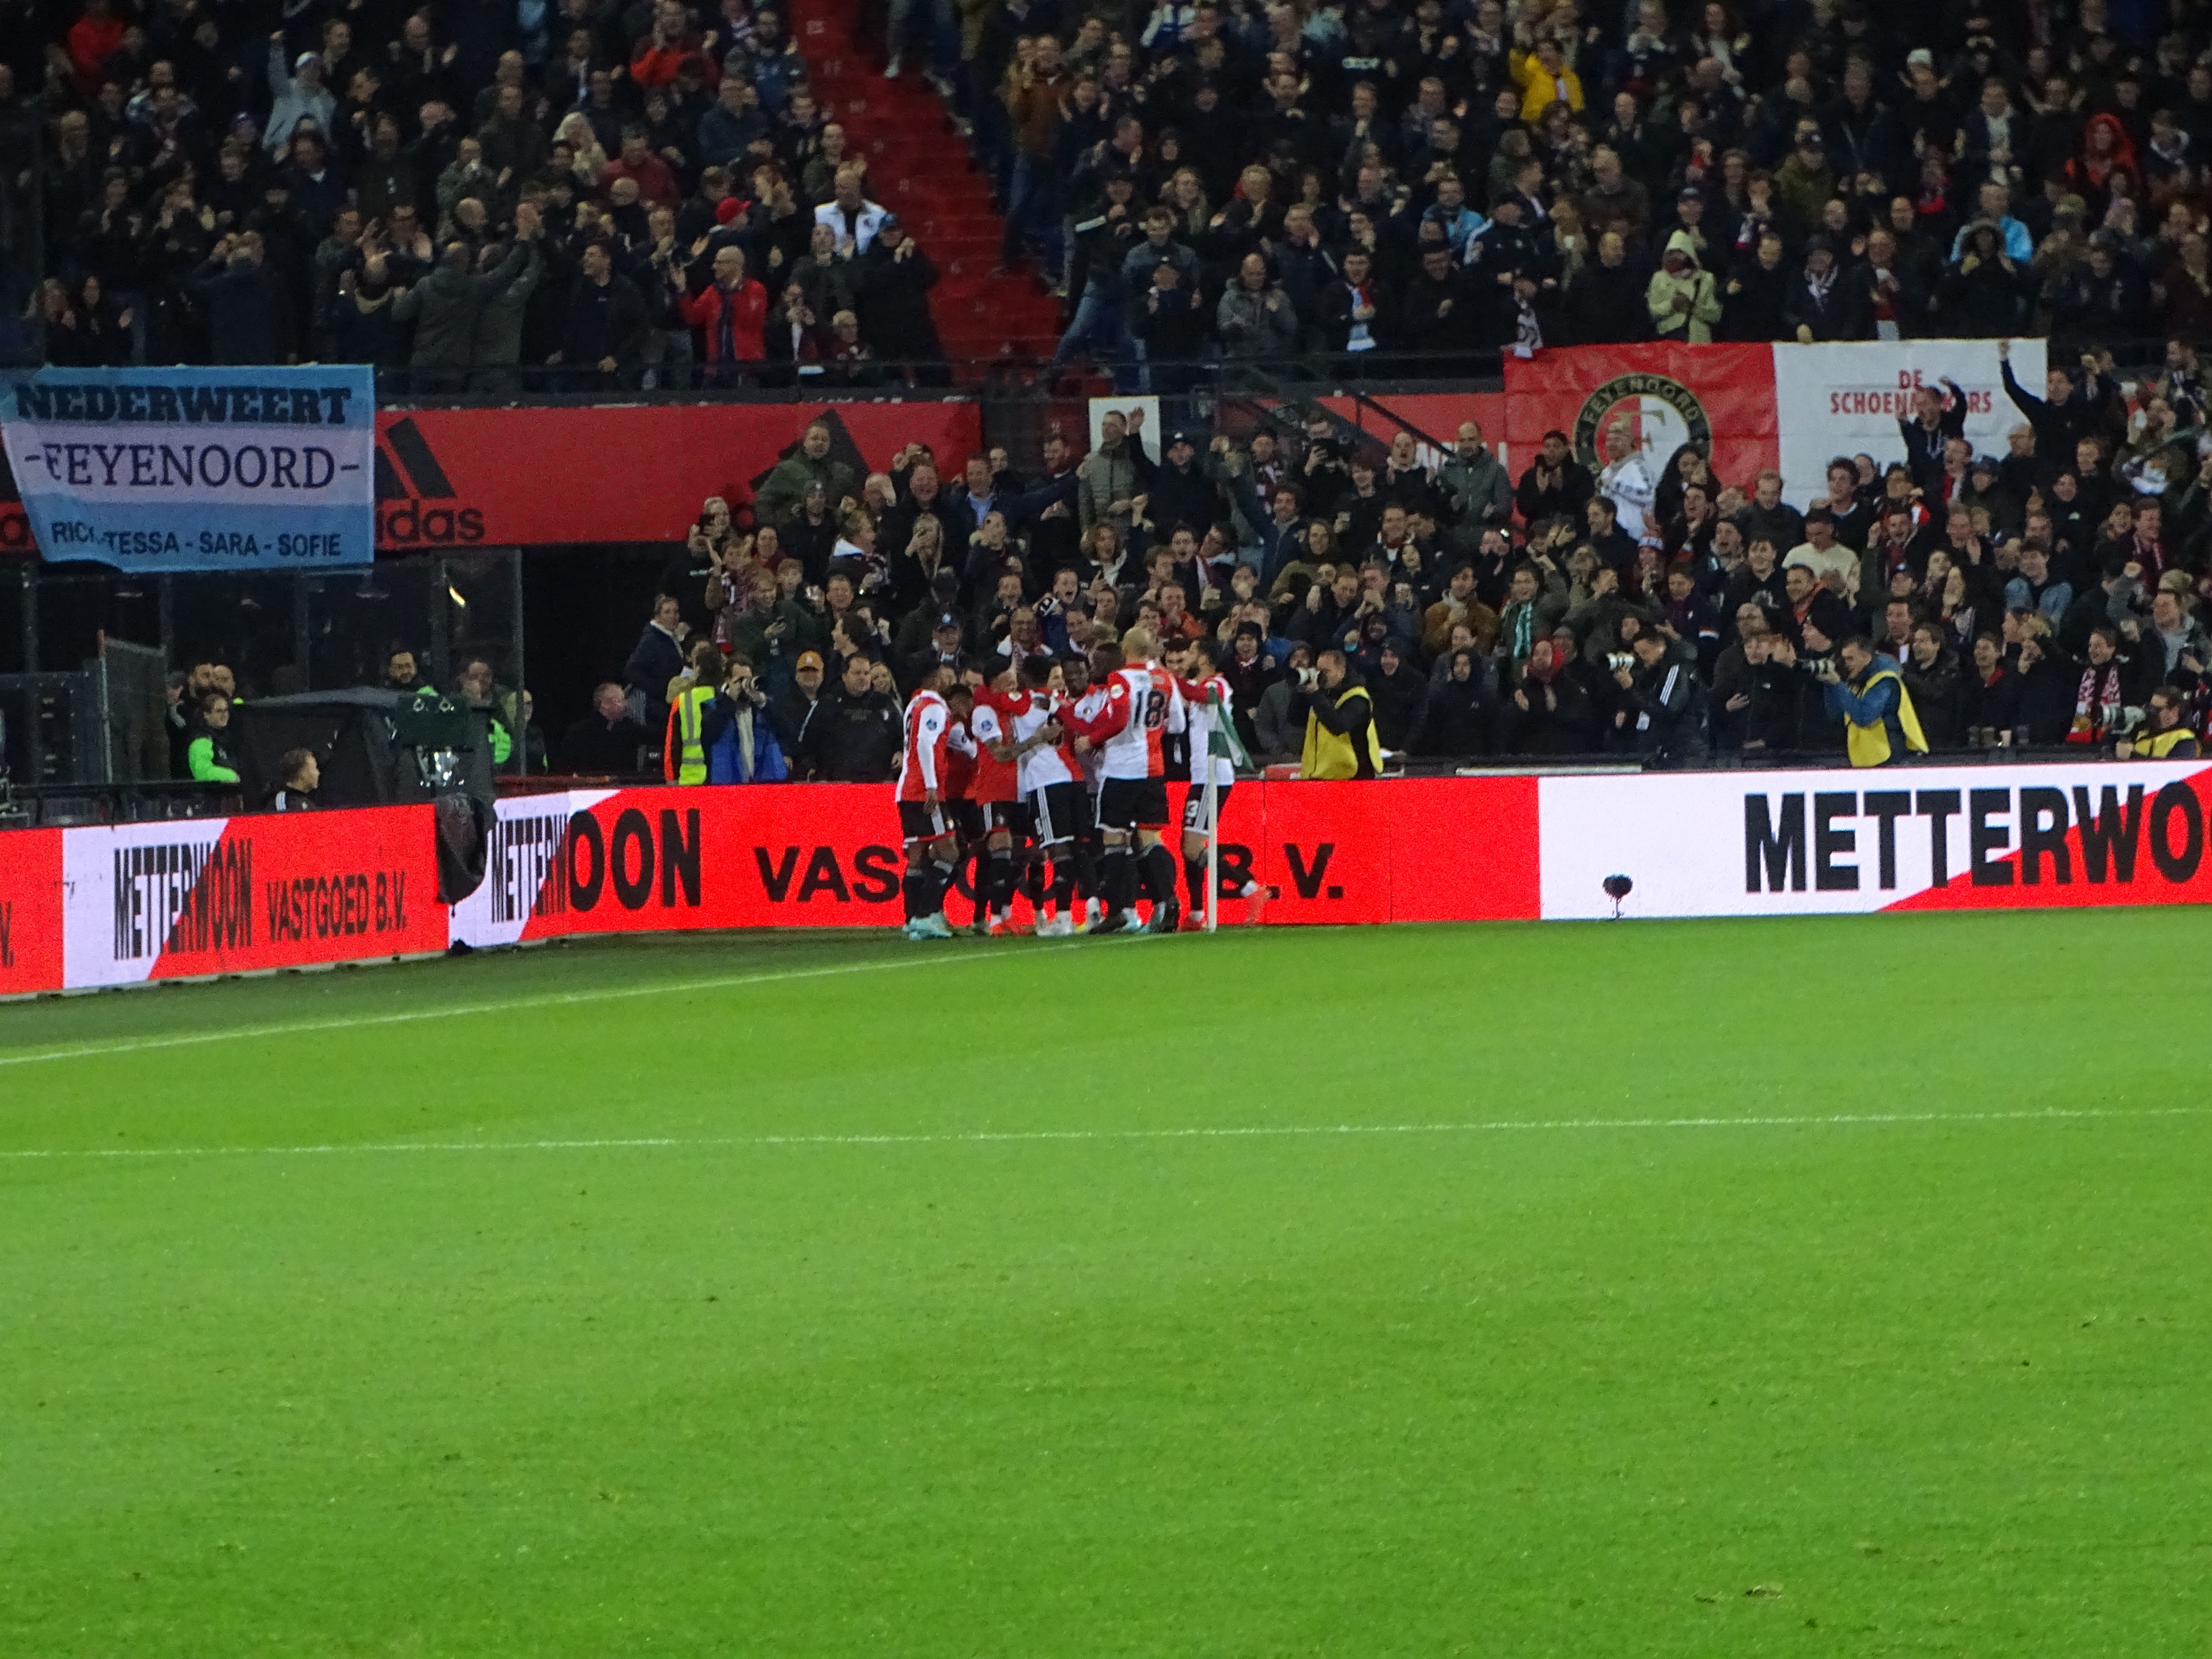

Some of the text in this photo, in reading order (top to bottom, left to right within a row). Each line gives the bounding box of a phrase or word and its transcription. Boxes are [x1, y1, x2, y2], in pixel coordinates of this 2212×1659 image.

[1898, 369, 1922, 389] DE
[14, 384, 352, 424] NEDERWEERT
[200, 532, 259, 556] SARA
[278, 533, 343, 556] SOFIE
[1134, 690, 1165, 729] 18
[1744, 780, 2212, 893] METTERWO
[114, 837, 407, 960] METTERWOON VASTGOED B.V.
